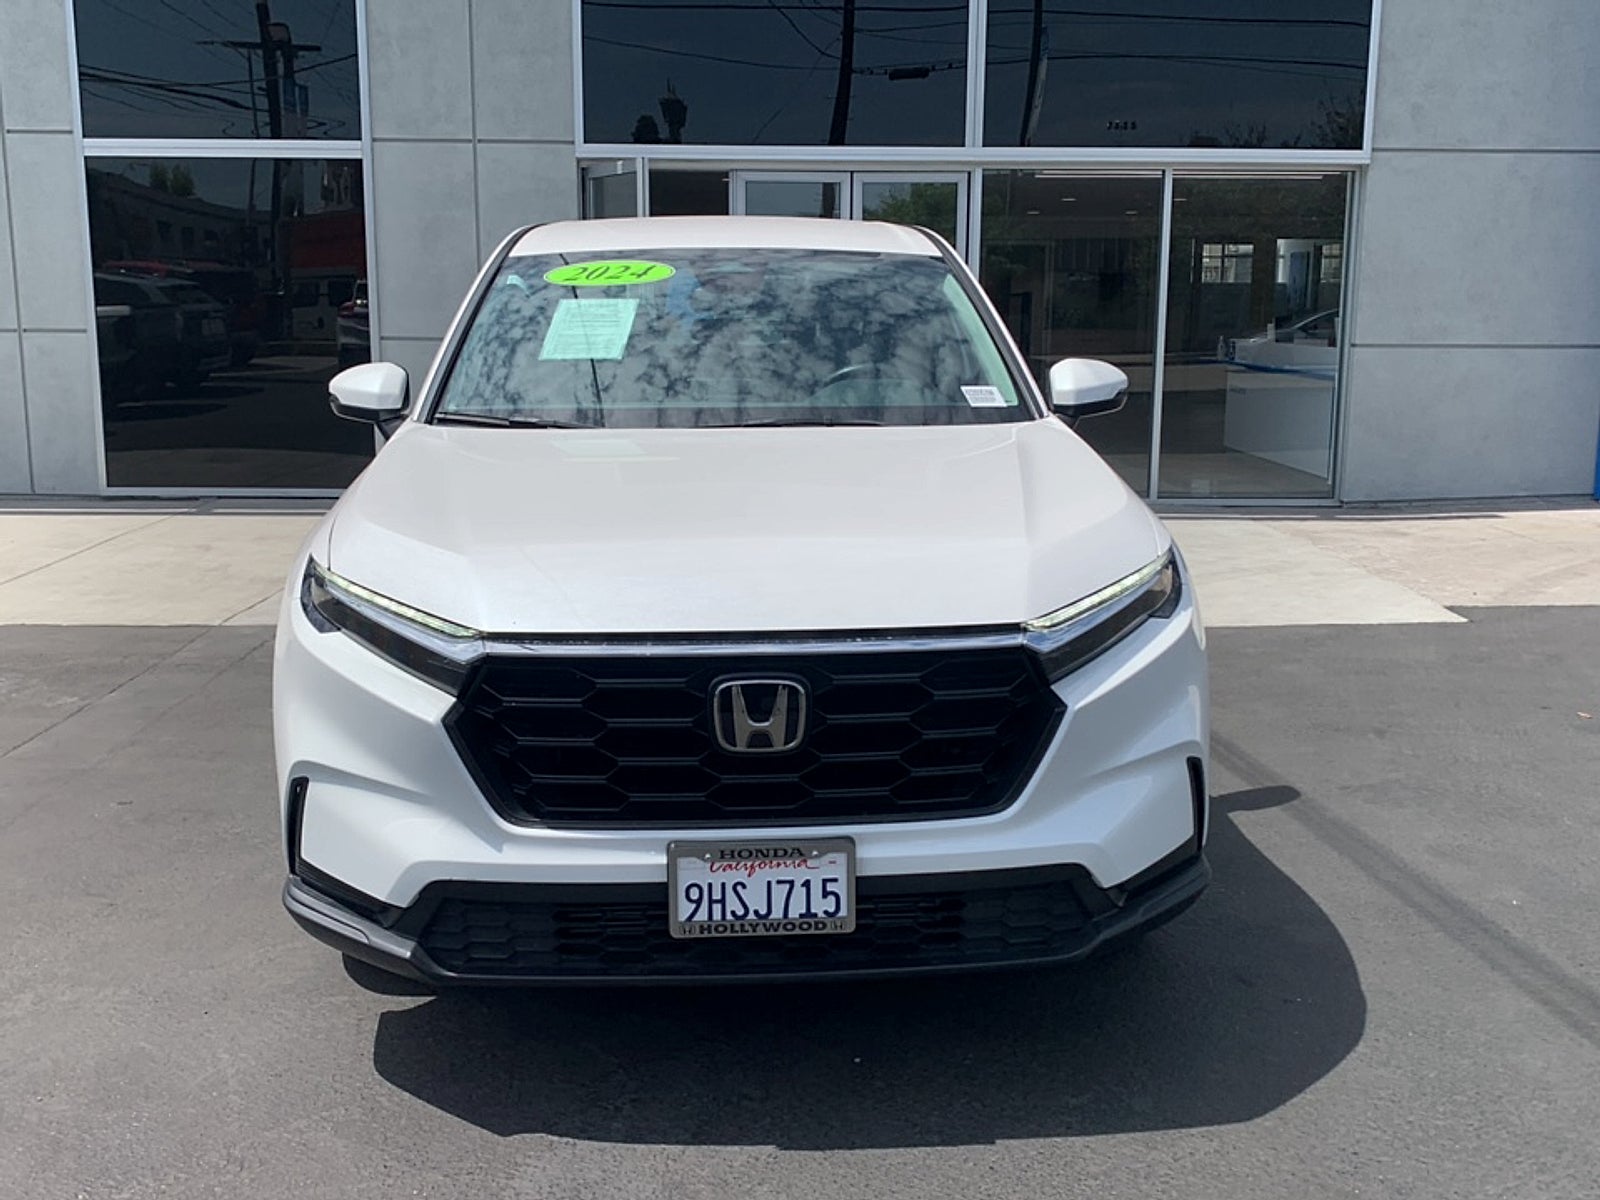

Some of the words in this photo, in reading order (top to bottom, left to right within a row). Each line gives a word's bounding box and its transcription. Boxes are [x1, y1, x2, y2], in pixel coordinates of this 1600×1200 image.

[562, 265, 656, 281] 2024
[720, 848, 804, 860] HONDA
[710, 859, 820, 877] California
[684, 878, 841, 922] 9HSJ715
[700, 921, 827, 935] HOLLYWOOD
